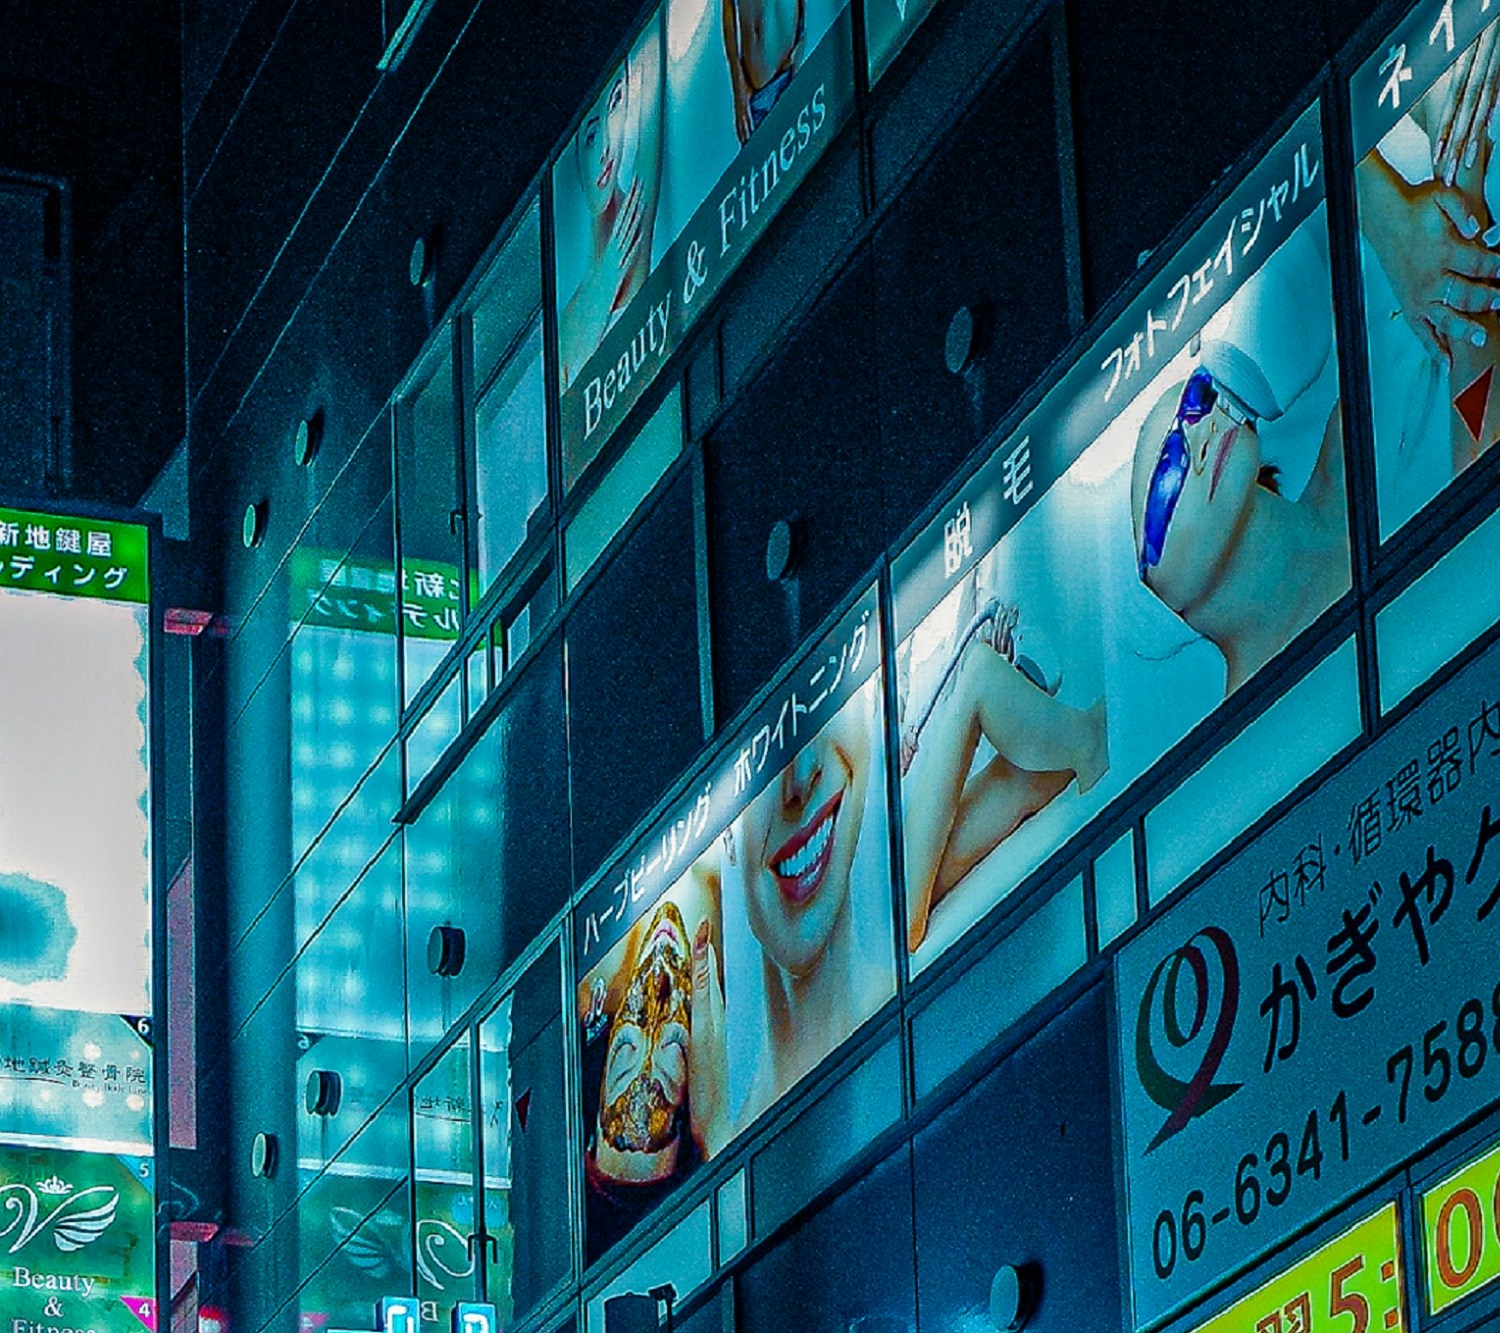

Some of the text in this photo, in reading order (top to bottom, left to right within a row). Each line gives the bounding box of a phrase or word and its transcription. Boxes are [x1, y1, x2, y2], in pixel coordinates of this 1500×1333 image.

[582, 91, 831, 440] Beauty & Fitness
[944, 142, 1325, 575] 脱毛 フォトフェイシャル
[582, 611, 871, 948] ハーブピーリング ホワイトニング
[138, 1018, 149, 1034] 6
[139, 1163, 149, 1177] 5
[13, 1266, 95, 1297] Beauty
[44, 1297, 63, 1317] &
[139, 1303, 150, 1318] 4
